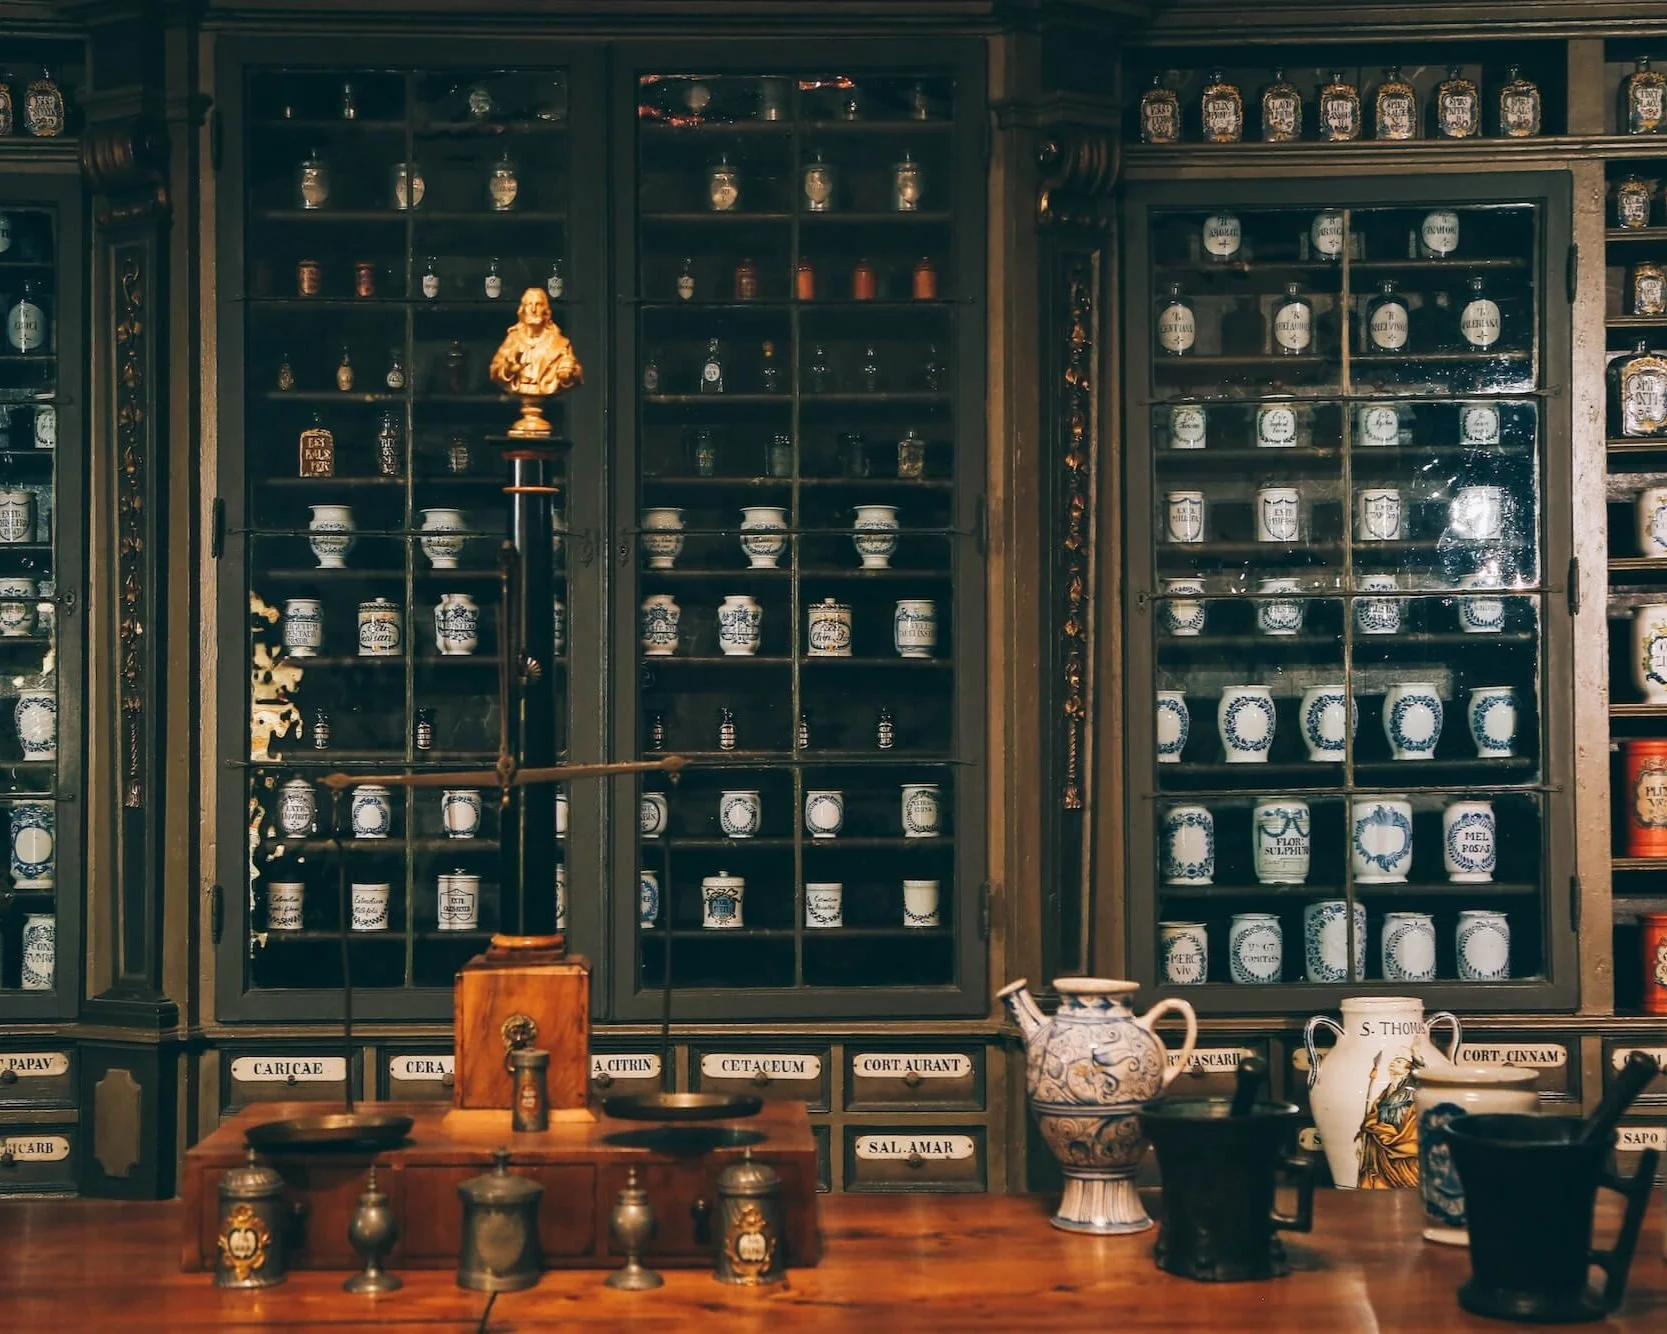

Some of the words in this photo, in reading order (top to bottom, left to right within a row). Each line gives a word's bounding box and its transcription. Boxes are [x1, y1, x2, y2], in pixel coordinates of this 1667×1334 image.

[1464, 831, 1489, 841] MEL
[1264, 846, 1309, 856] SULPHUR
[1506, 1050, 1559, 1062] CINNAM
[8, 1057, 54, 1070] PAPAV
[253, 1062, 323, 1075] CARICAE
[721, 1058, 804, 1073] CETACEUM
[903, 1059, 961, 1072] AURANT
[1624, 1132, 1658, 1144] SAPO
[909, 1141, 954, 1154] AMAR
